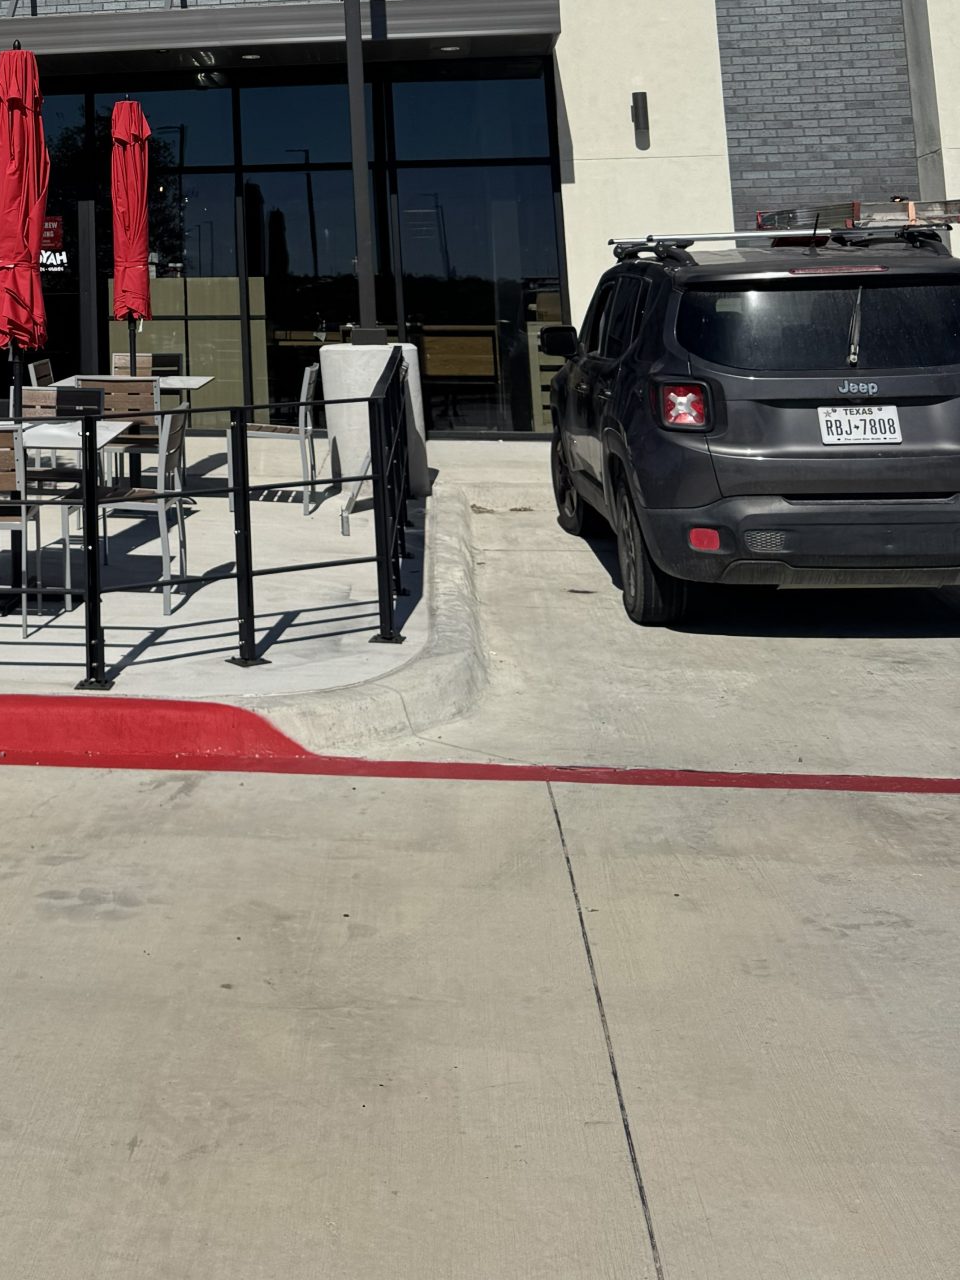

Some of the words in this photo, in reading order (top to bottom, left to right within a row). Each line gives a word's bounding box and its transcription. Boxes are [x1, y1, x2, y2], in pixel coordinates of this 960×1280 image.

[40, 249, 68, 265] YAH
[838, 380, 878, 396] Jeep
[843, 407, 874, 416] TEXAS
